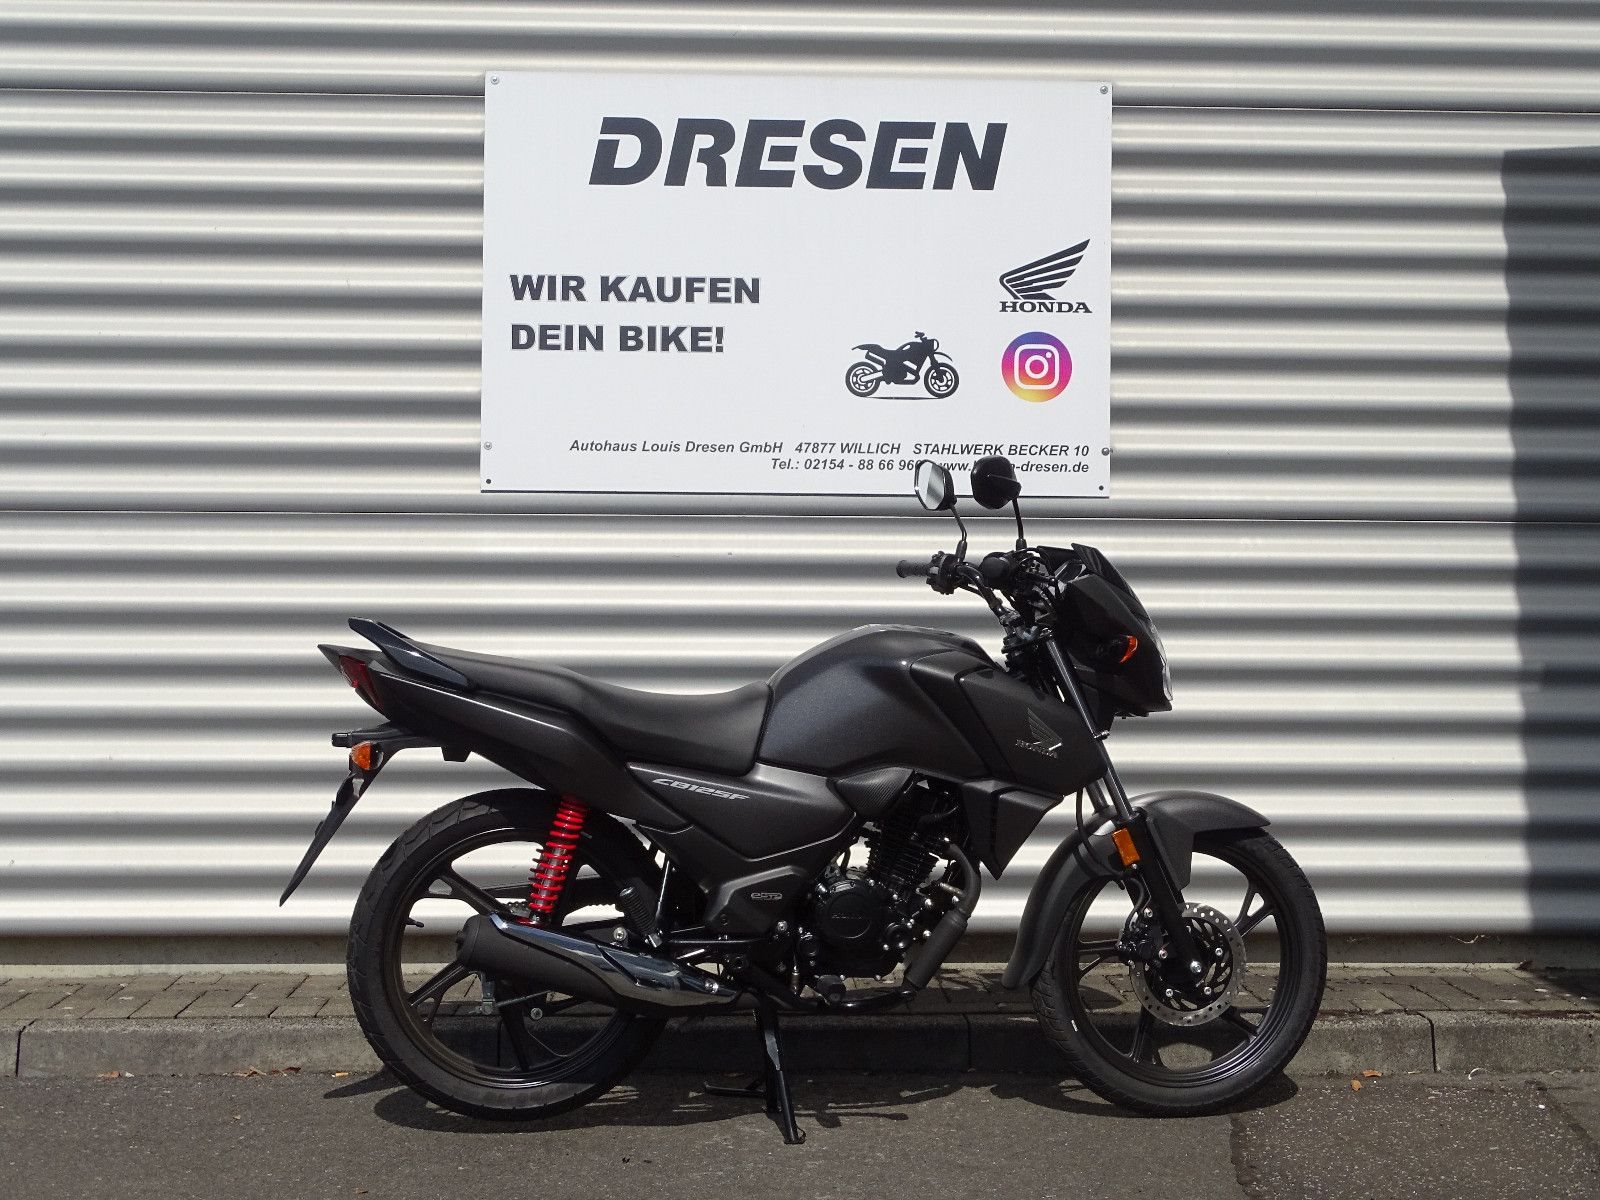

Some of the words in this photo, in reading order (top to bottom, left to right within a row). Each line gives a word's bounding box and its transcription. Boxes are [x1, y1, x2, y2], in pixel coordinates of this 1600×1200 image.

[589, 117, 1008, 190] DRESEN
[510, 274, 586, 302] WIR
[601, 275, 760, 304] KAUFEN
[999, 301, 1092, 314] HONDA
[511, 324, 603, 351] DEIN
[619, 325, 724, 353] BIKE!
[569, 439, 637, 452] Autohaus
[641, 440, 681, 453] Louis
[685, 441, 735, 453] Dresen
[739, 441, 784, 454] GmbH
[794, 442, 836, 454] 47877
[840, 442, 901, 455] WILLICH
[912, 443, 1005, 456] STAHLWERK
[1008, 444, 1069, 456] BECKER
[1074, 445, 1090, 457] 10
[771, 458, 800, 470] Tel.:
[804, 458, 845, 470] 02154
[857, 459, 874, 471] 88
[878, 459, 895, 471] 66
[652, 778, 750, 800] CB125F
